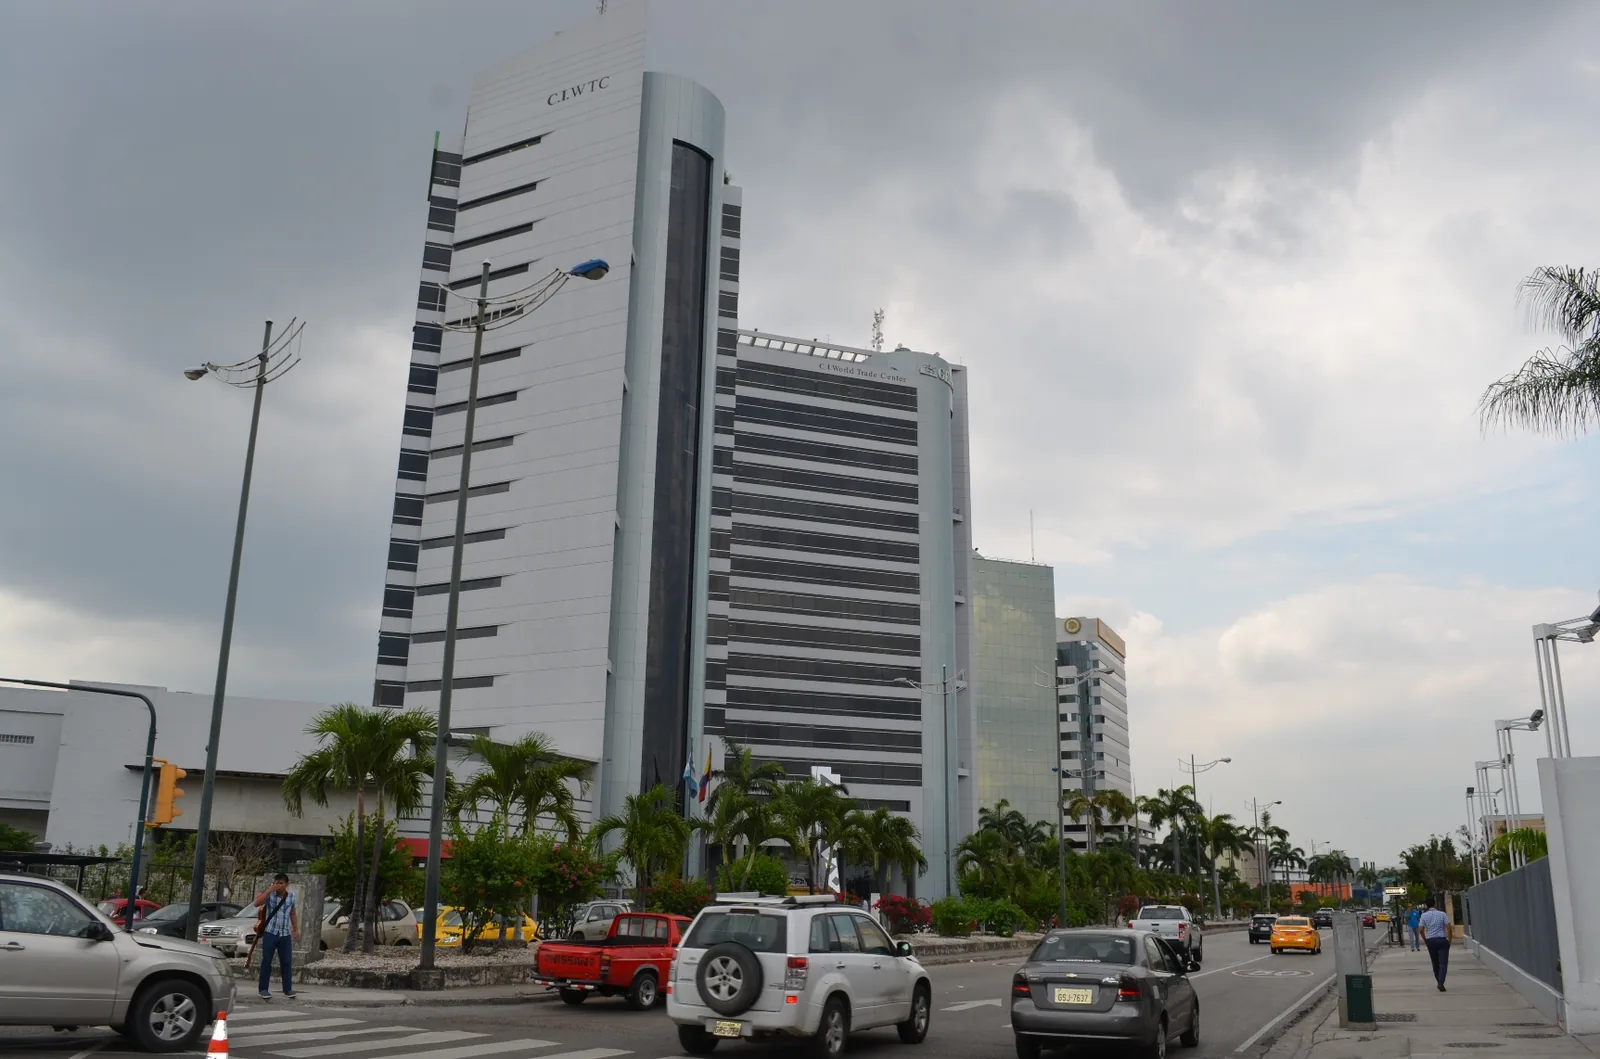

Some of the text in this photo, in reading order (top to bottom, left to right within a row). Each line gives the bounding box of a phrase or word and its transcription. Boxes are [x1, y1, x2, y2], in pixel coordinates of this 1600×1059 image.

[856, 368, 878, 378] Trade
[880, 372, 907, 383] Center
[552, 955, 590, 967] NISSAN
[1057, 993, 1088, 1003] GSJ-7637
